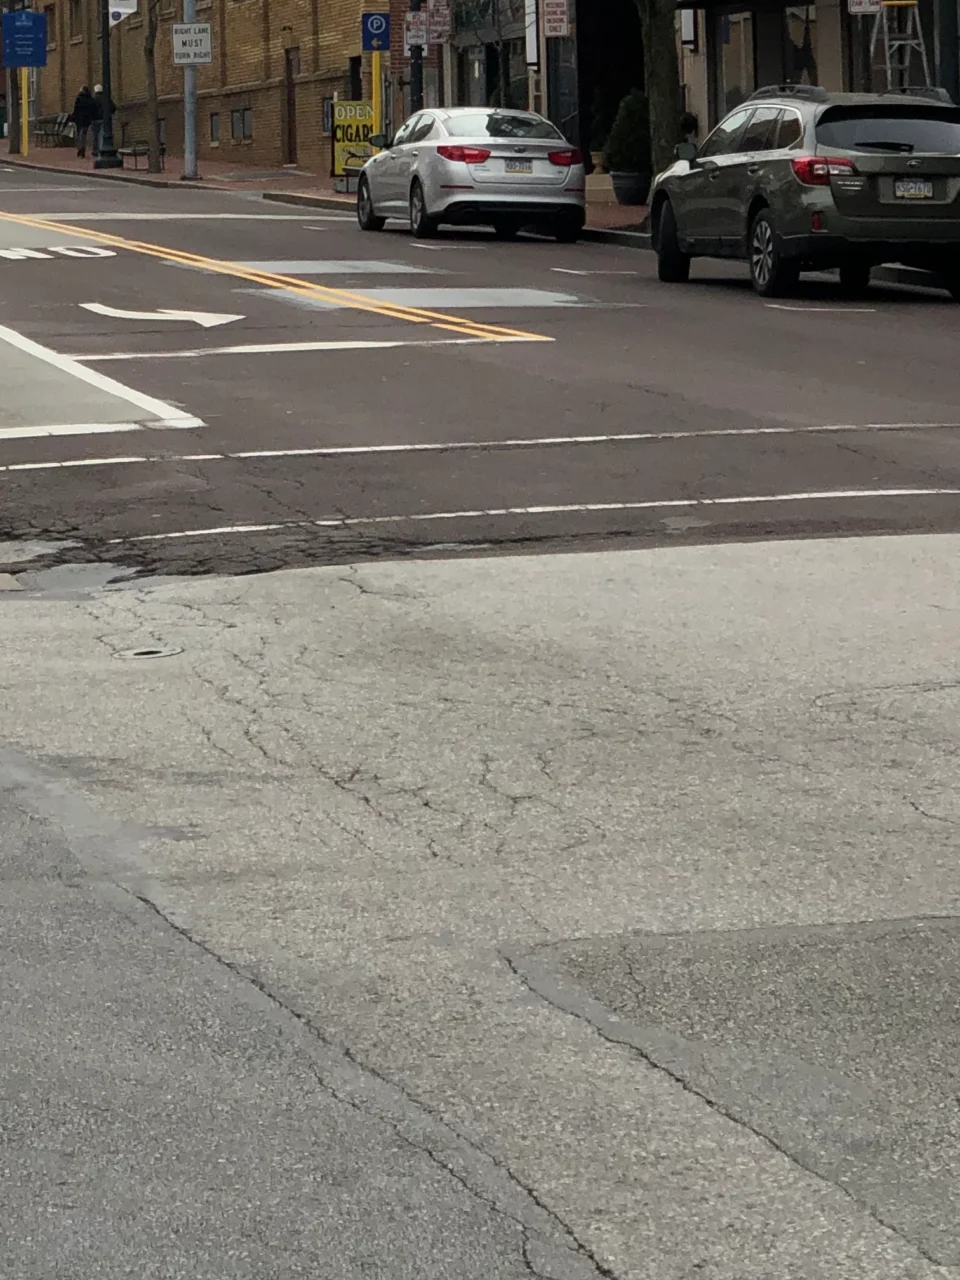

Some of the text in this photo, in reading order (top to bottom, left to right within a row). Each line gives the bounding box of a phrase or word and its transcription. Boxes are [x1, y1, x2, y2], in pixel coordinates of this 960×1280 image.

[175, 27, 192, 35] RIGHT
[182, 39, 203, 48] MUST
[175, 51, 210, 59] TURN RIGHT
[335, 124, 374, 142] CIGAR
